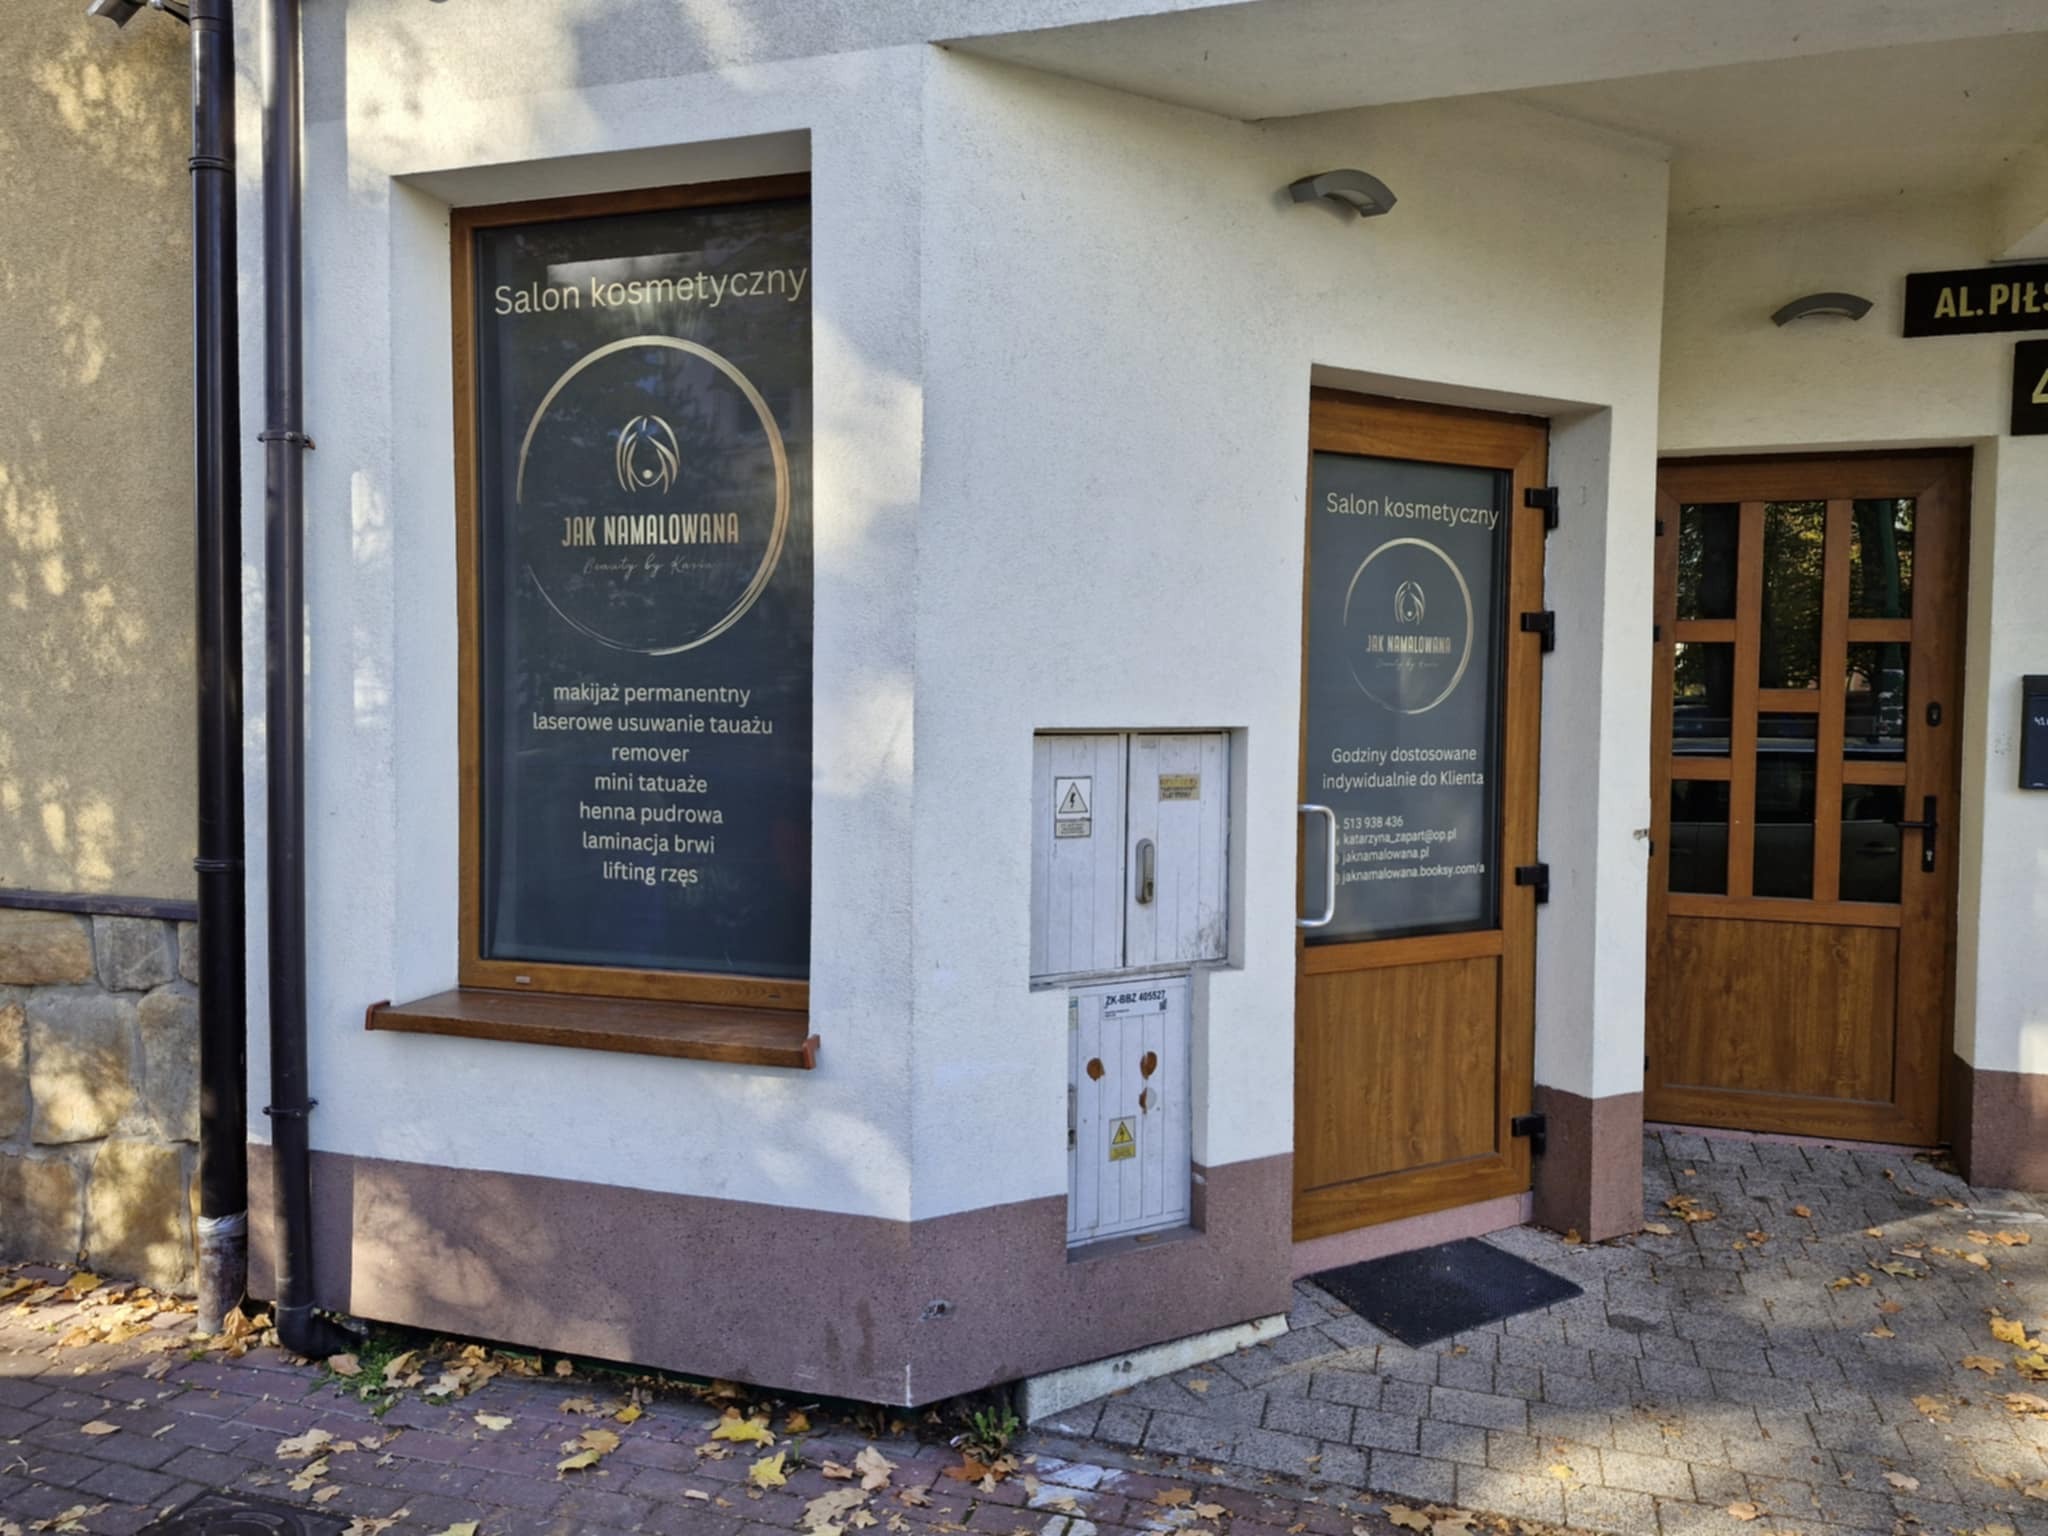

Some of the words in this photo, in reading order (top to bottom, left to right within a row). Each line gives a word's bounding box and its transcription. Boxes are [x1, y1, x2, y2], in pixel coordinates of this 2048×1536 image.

[495, 281, 580, 315] Salon
[591, 267, 807, 308] kosmetyczny
[1327, 492, 1378, 516] Salon
[1384, 496, 1499, 530] kosmetyczny
[562, 516, 597, 547] JAK
[603, 512, 740, 546] NAMALOWANA
[1366, 635, 1385, 653] JAK
[1387, 635, 1452, 654] NAMALOWANA
[553, 683, 619, 705] makijaż
[624, 685, 751, 707] permanentny
[533, 712, 612, 730] laserowe
[618, 714, 704, 732] usuwanie
[611, 746, 689, 762] remover
[1331, 748, 1387, 766] Godziny
[1391, 747, 1477, 763] dostosowane
[595, 773, 633, 791] mini
[638, 774, 708, 793] tatuaże
[1323, 773, 1417, 792] indywidualnie
[1420, 771, 1436, 786] do
[1440, 770, 1484, 786] Klienta
[579, 802, 636, 821] henna
[641, 804, 723, 825] pudrowa
[1343, 817, 1361, 830] 513
[582, 831, 669, 855] laminacja
[674, 835, 715, 854] brwi
[603, 861, 656, 885] lifting
[660, 869, 699, 886] rzęs
